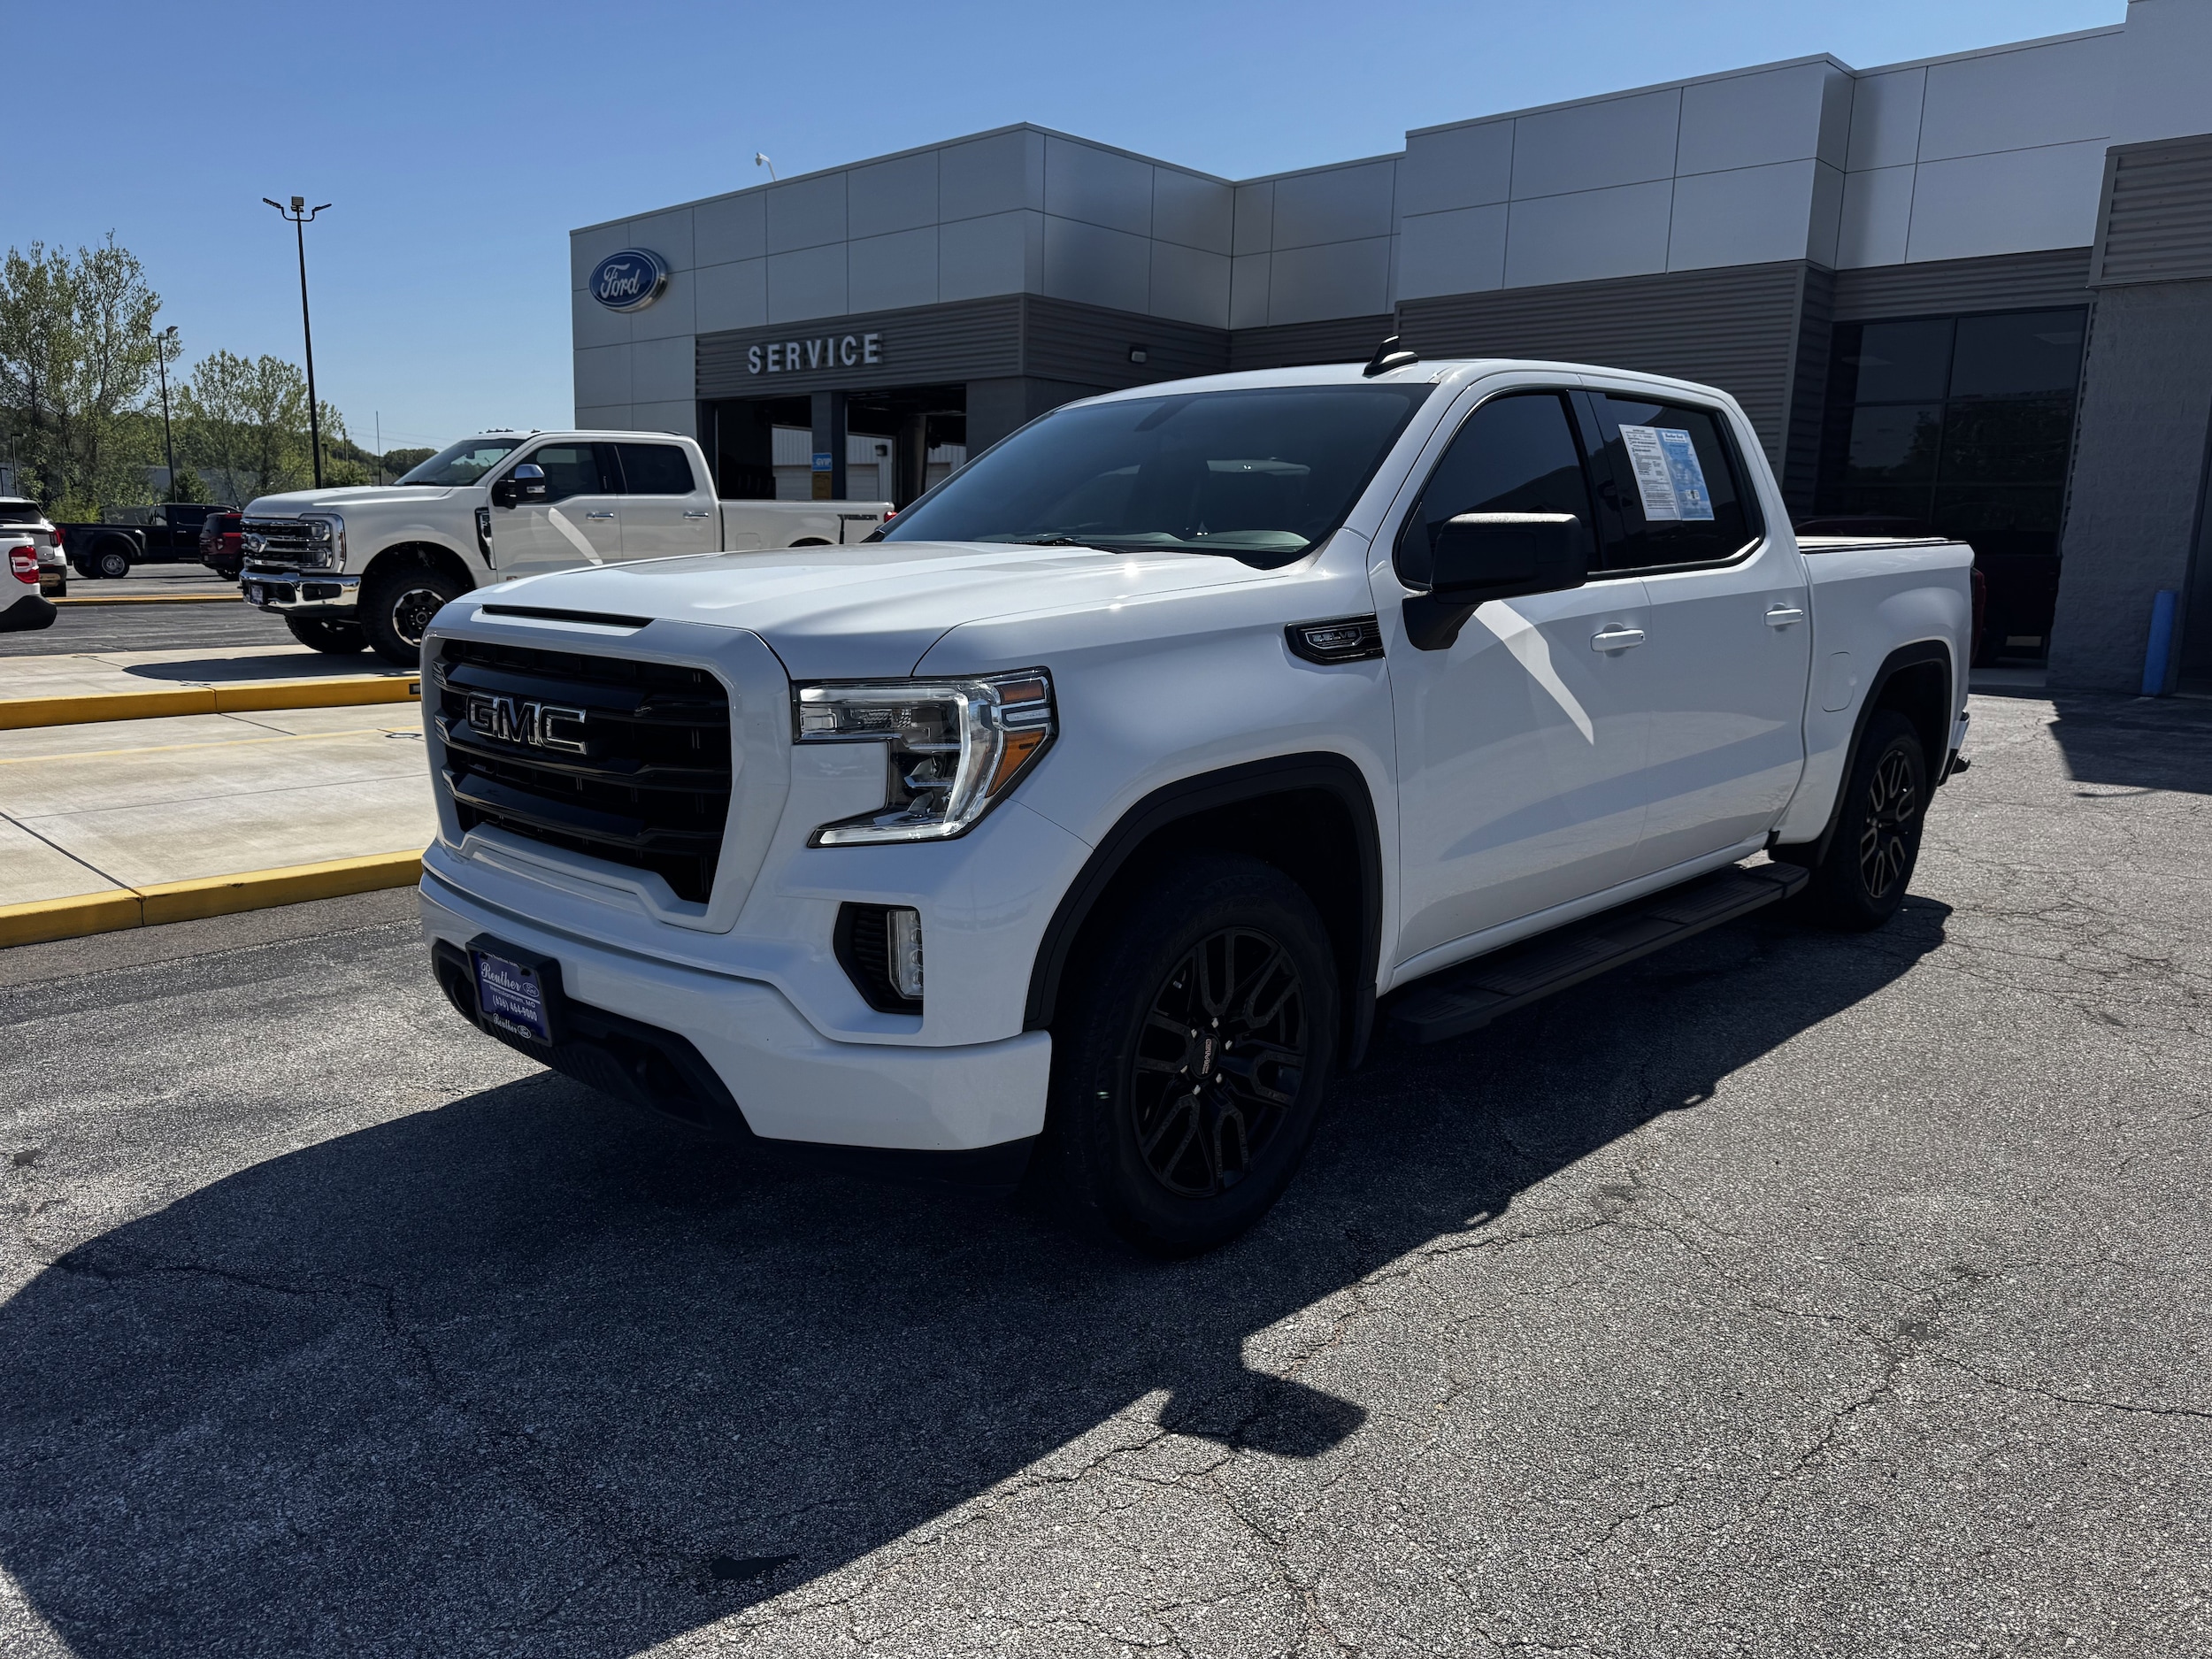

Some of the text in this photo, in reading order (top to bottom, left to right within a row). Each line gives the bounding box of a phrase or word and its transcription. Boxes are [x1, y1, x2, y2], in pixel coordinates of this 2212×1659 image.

[600, 263, 640, 299] Ford
[748, 334, 881, 374] SERVICE
[465, 691, 588, 755] GMC
